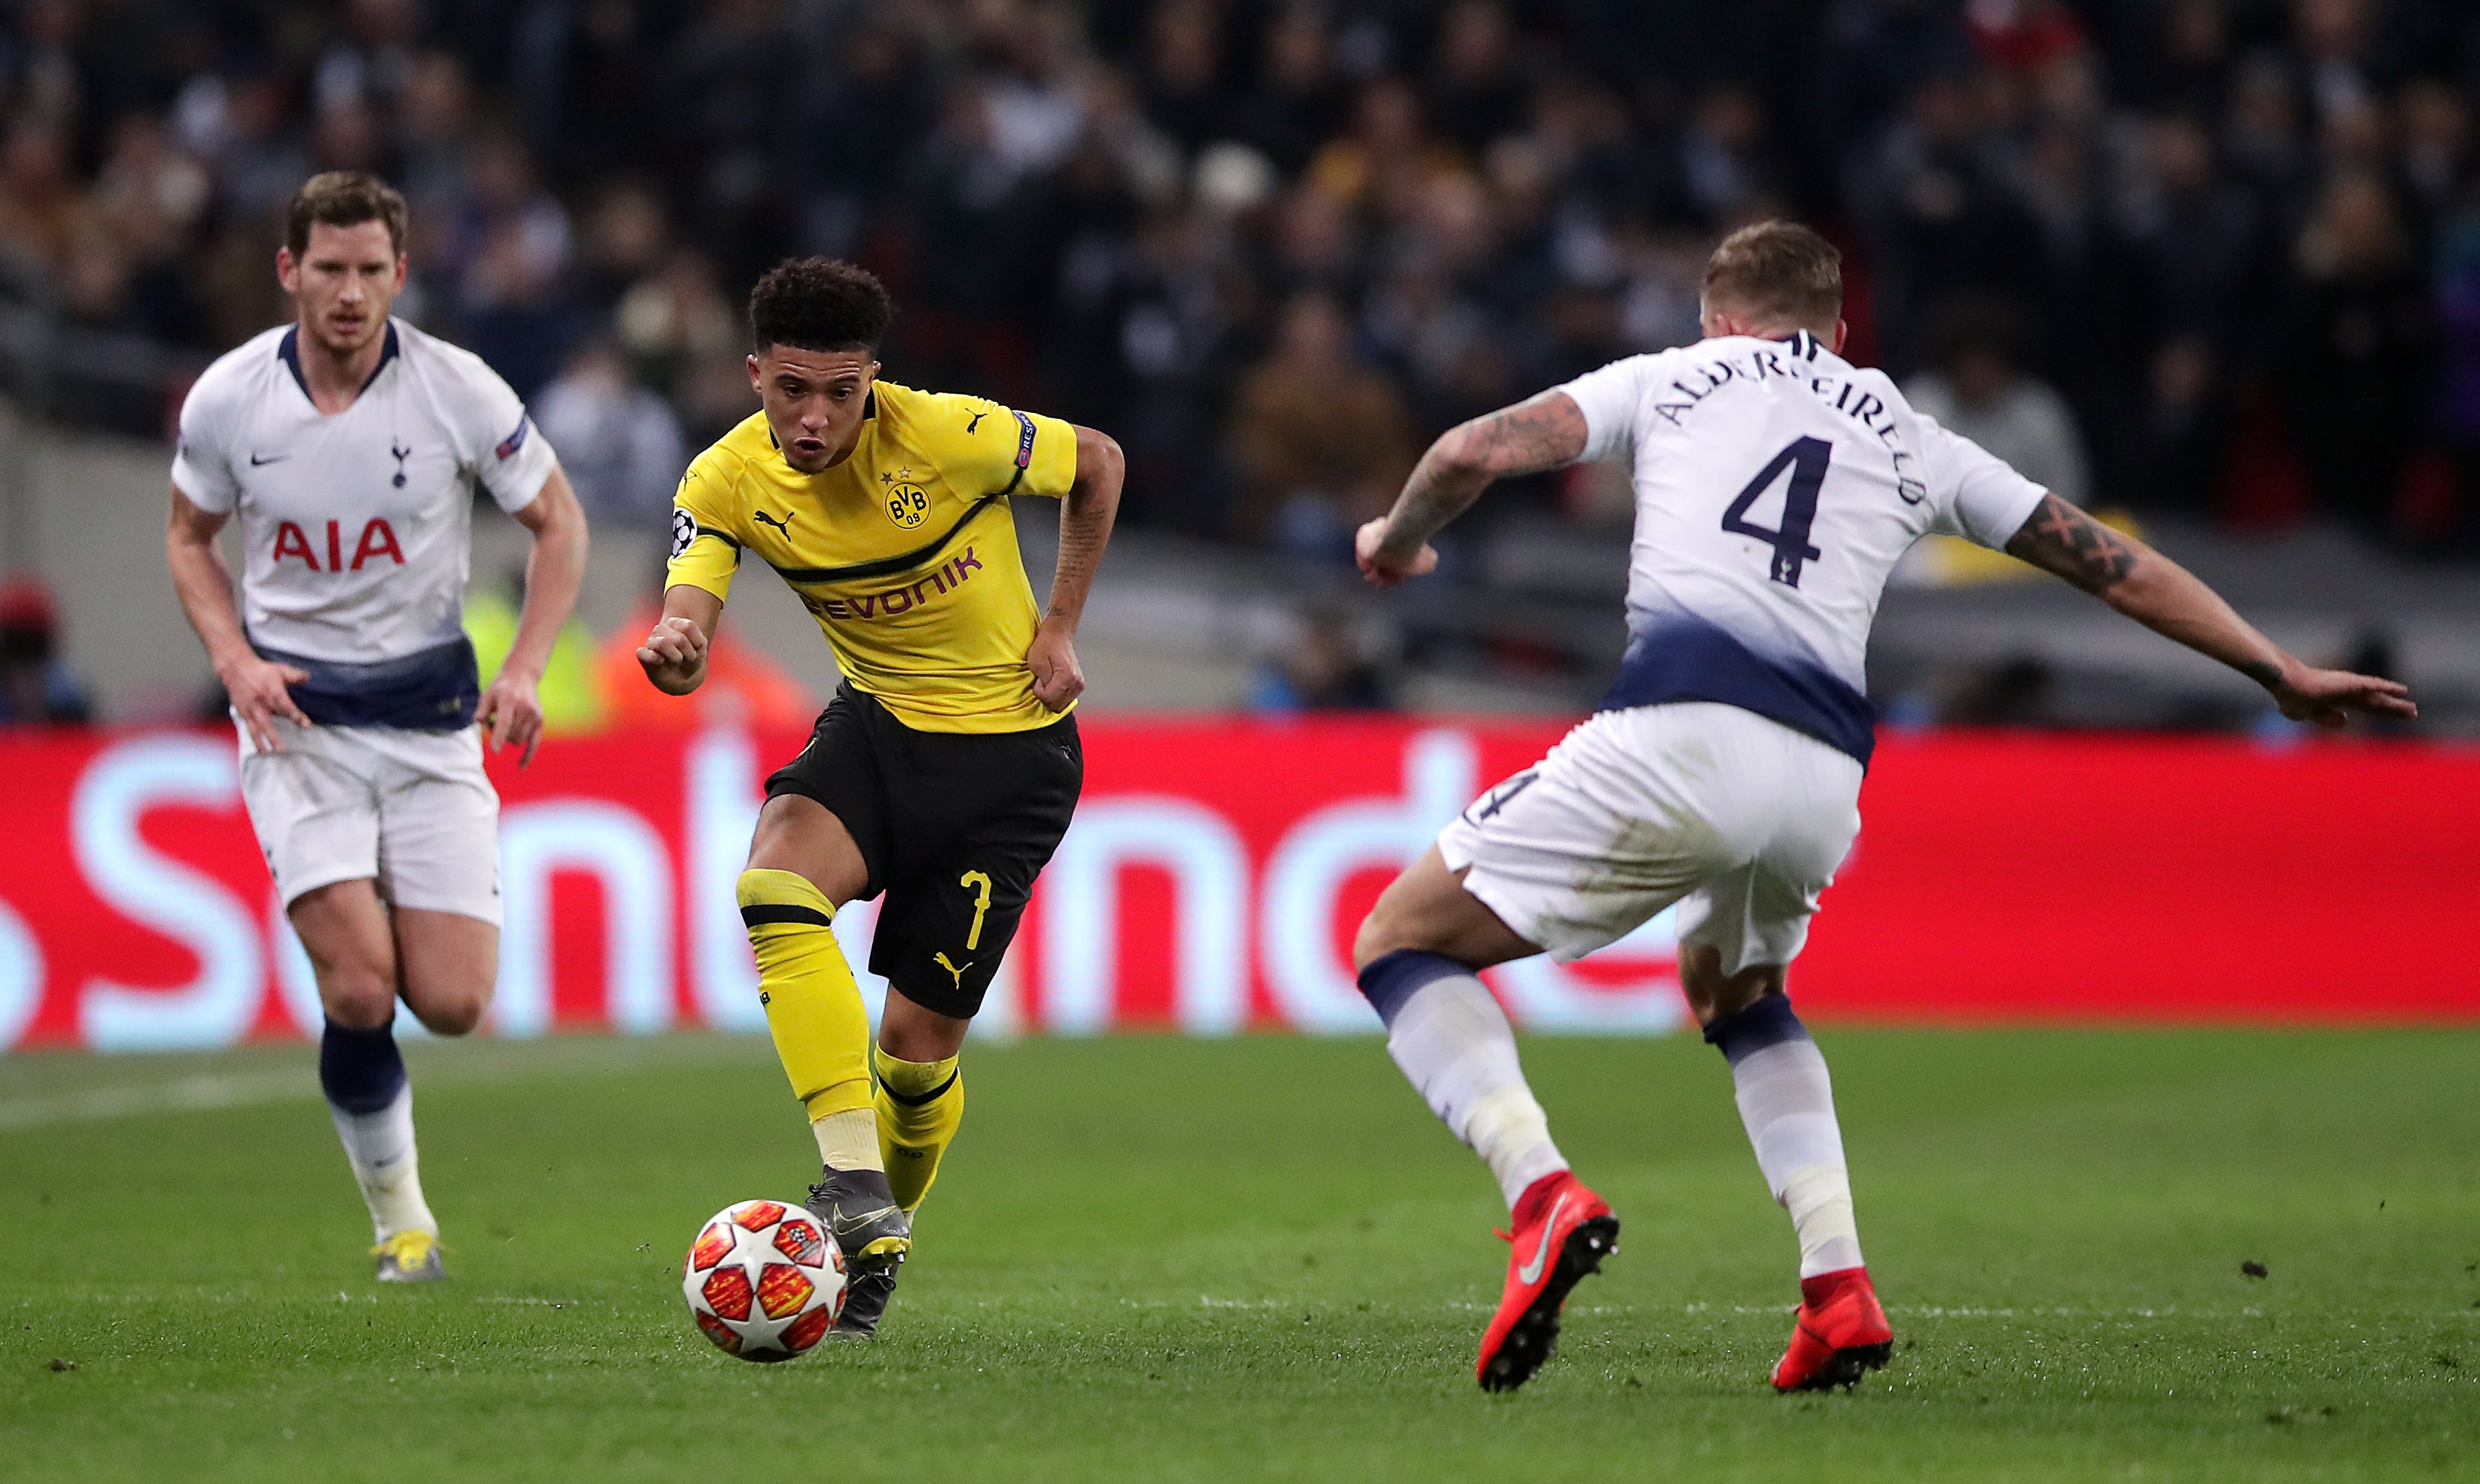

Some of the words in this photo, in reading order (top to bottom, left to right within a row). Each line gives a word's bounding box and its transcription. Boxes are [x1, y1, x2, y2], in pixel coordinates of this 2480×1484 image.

[889, 486, 927, 520] BVB
[906, 512, 921, 525] 09
[1722, 435, 1832, 589] 4
[274, 516, 406, 572] AIA
[960, 870, 992, 950] 7
